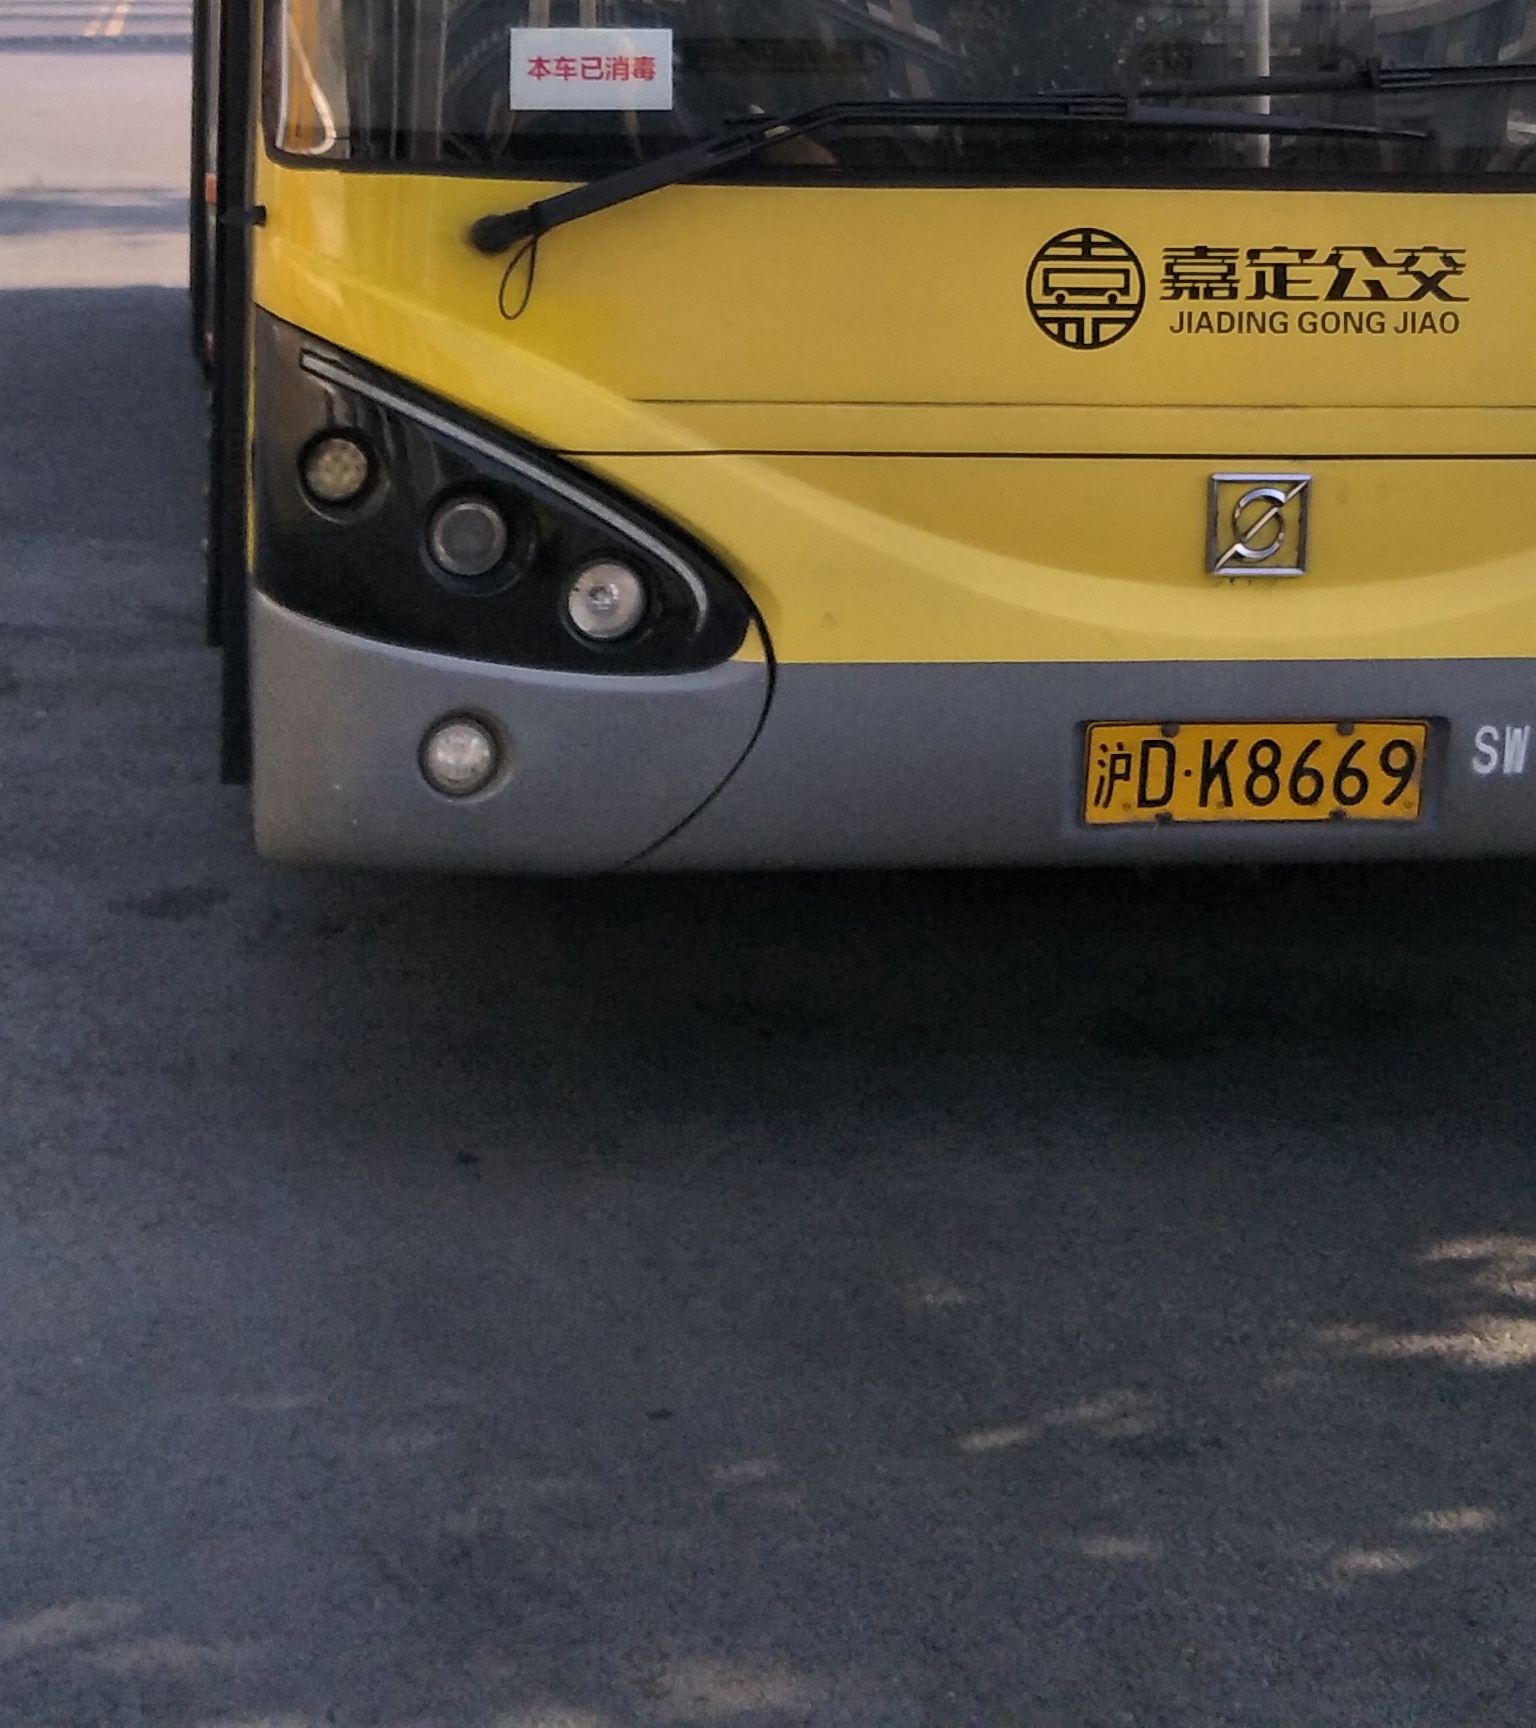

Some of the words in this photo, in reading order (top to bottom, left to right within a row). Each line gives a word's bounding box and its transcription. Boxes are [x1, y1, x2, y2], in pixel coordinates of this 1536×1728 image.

[527, 55, 657, 82] 本车已消毒
[1160, 245, 1470, 302] 嘉定公交
[1169, 310, 1289, 334] JIADING
[1297, 310, 1387, 334] GONG
[1393, 310, 1460, 334] JIAO
